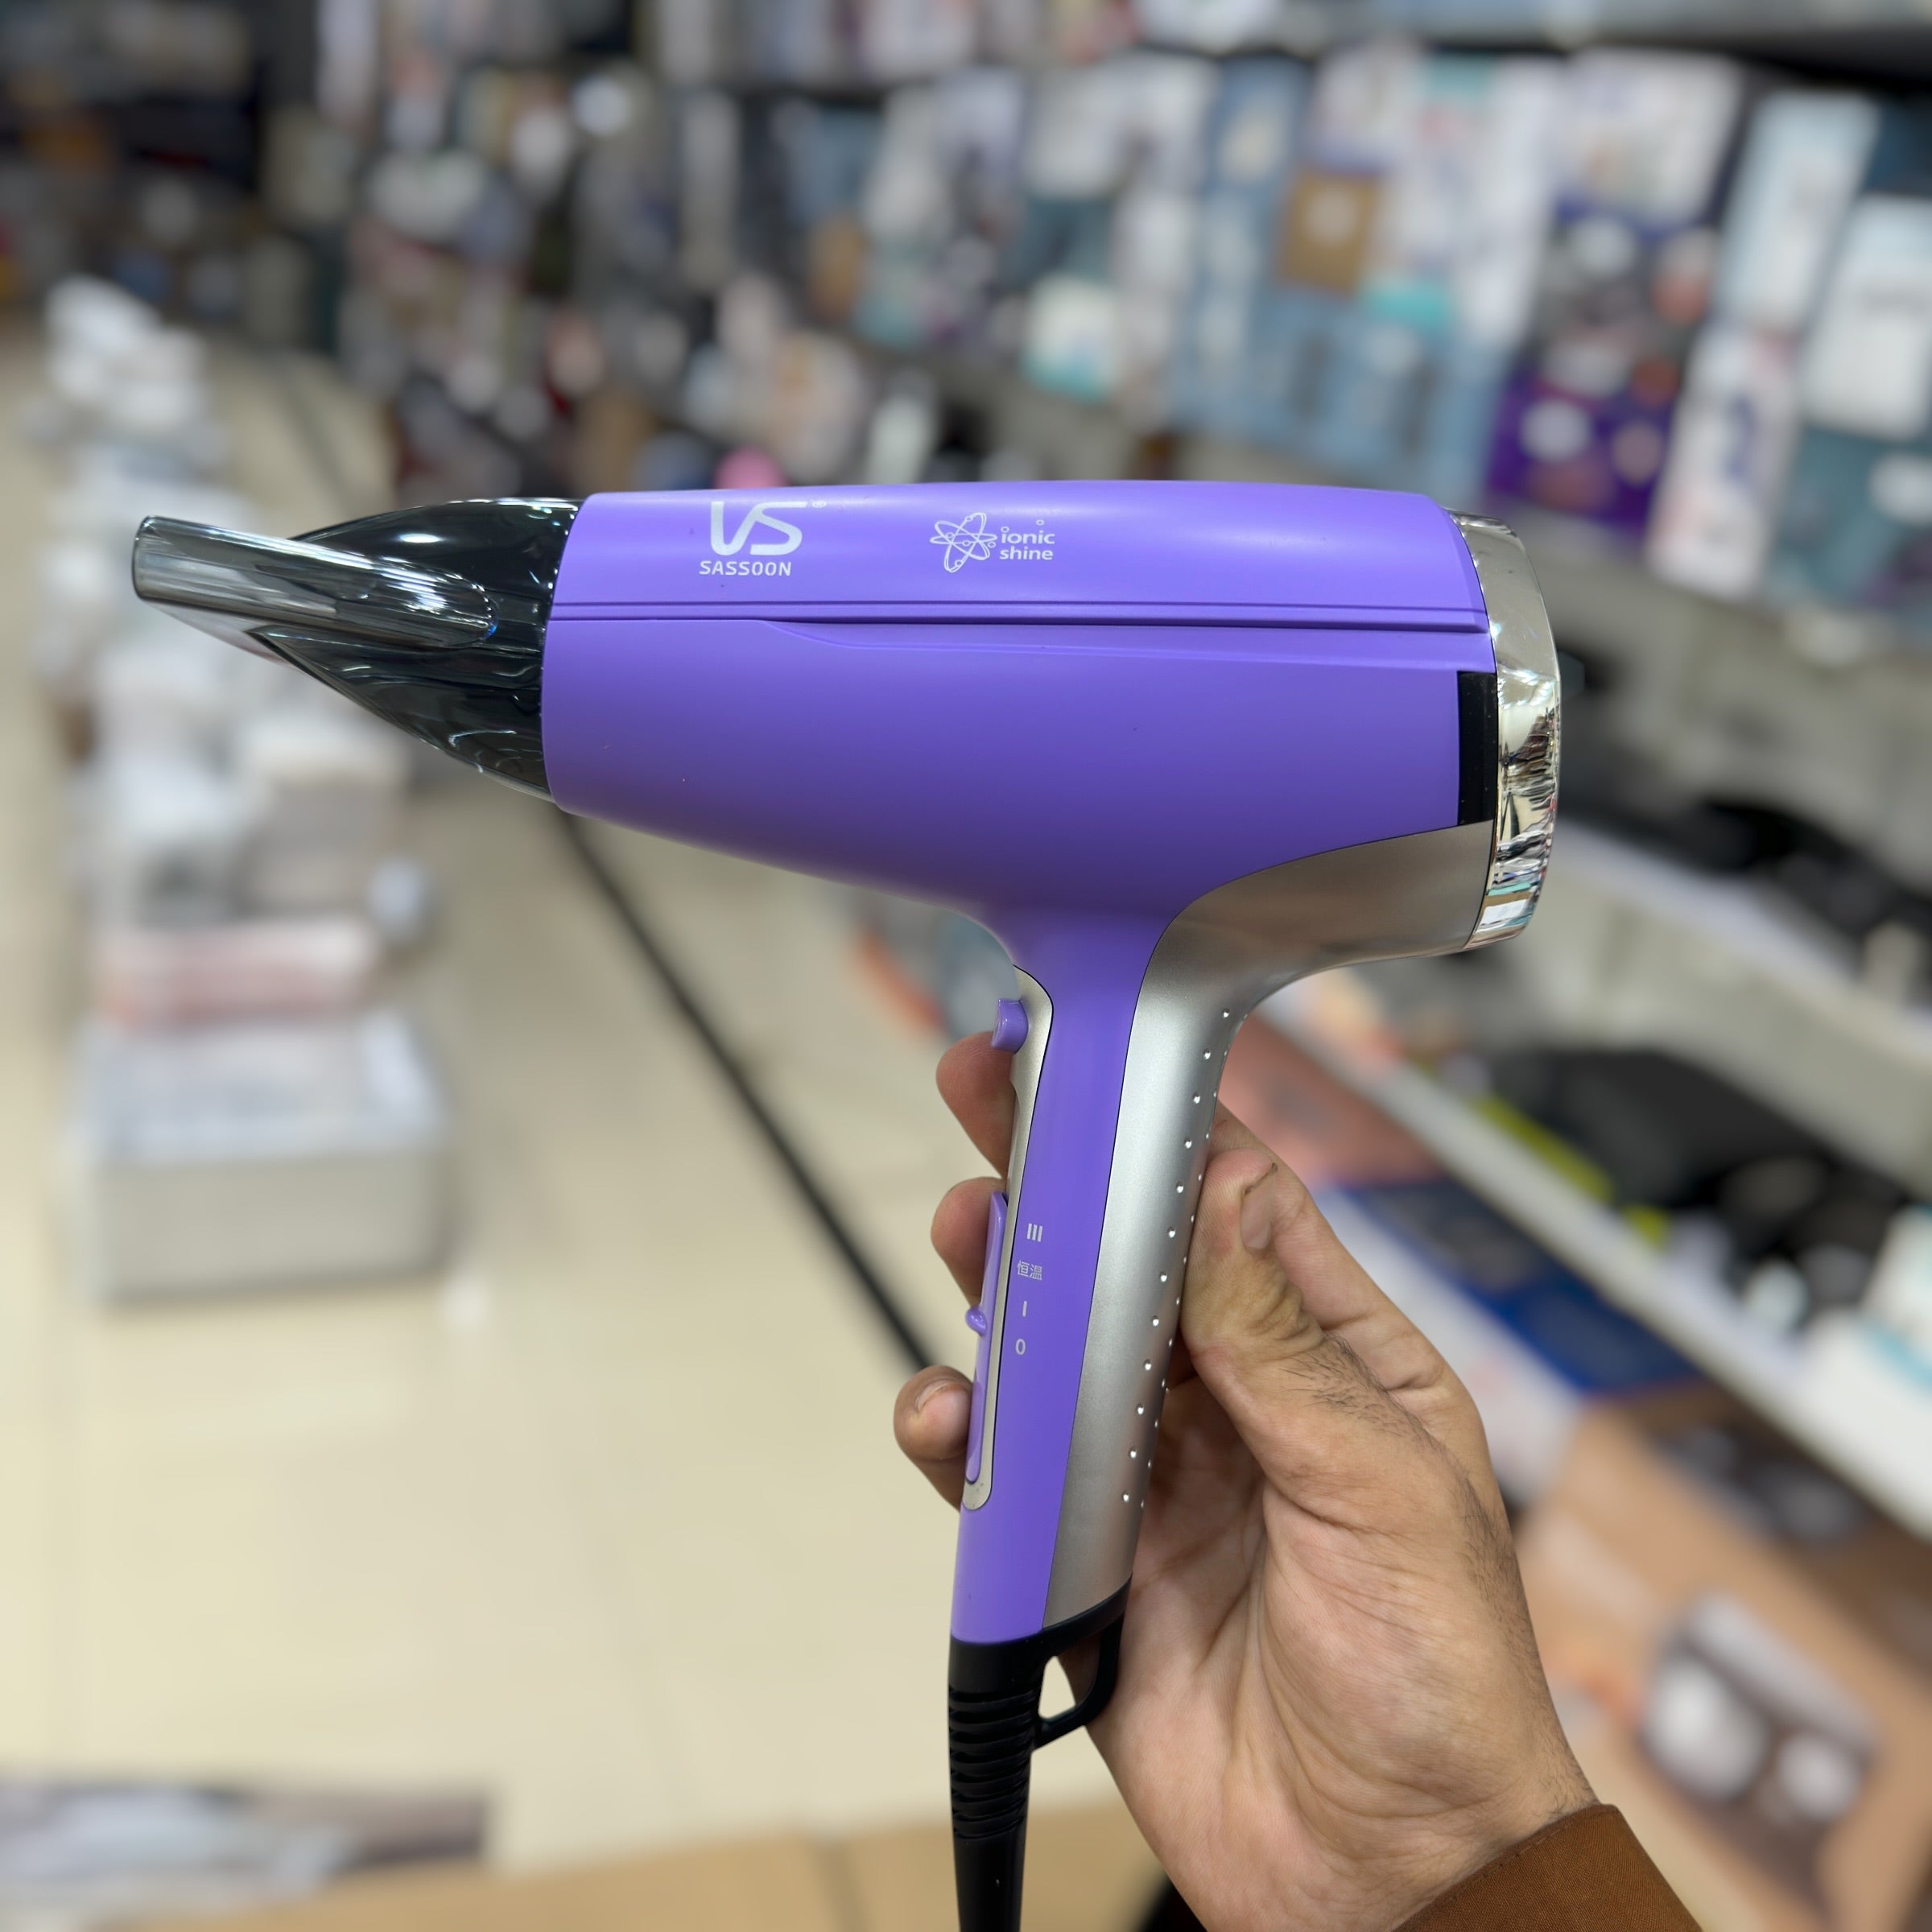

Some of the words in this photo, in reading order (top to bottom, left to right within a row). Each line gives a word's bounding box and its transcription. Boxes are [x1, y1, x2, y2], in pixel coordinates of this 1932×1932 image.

[1000, 520, 1055, 545] ionic
[999, 546, 1054, 561] shine
[699, 560, 792, 576] SASSOON
[1017, 1260, 1043, 1281] 恒温
